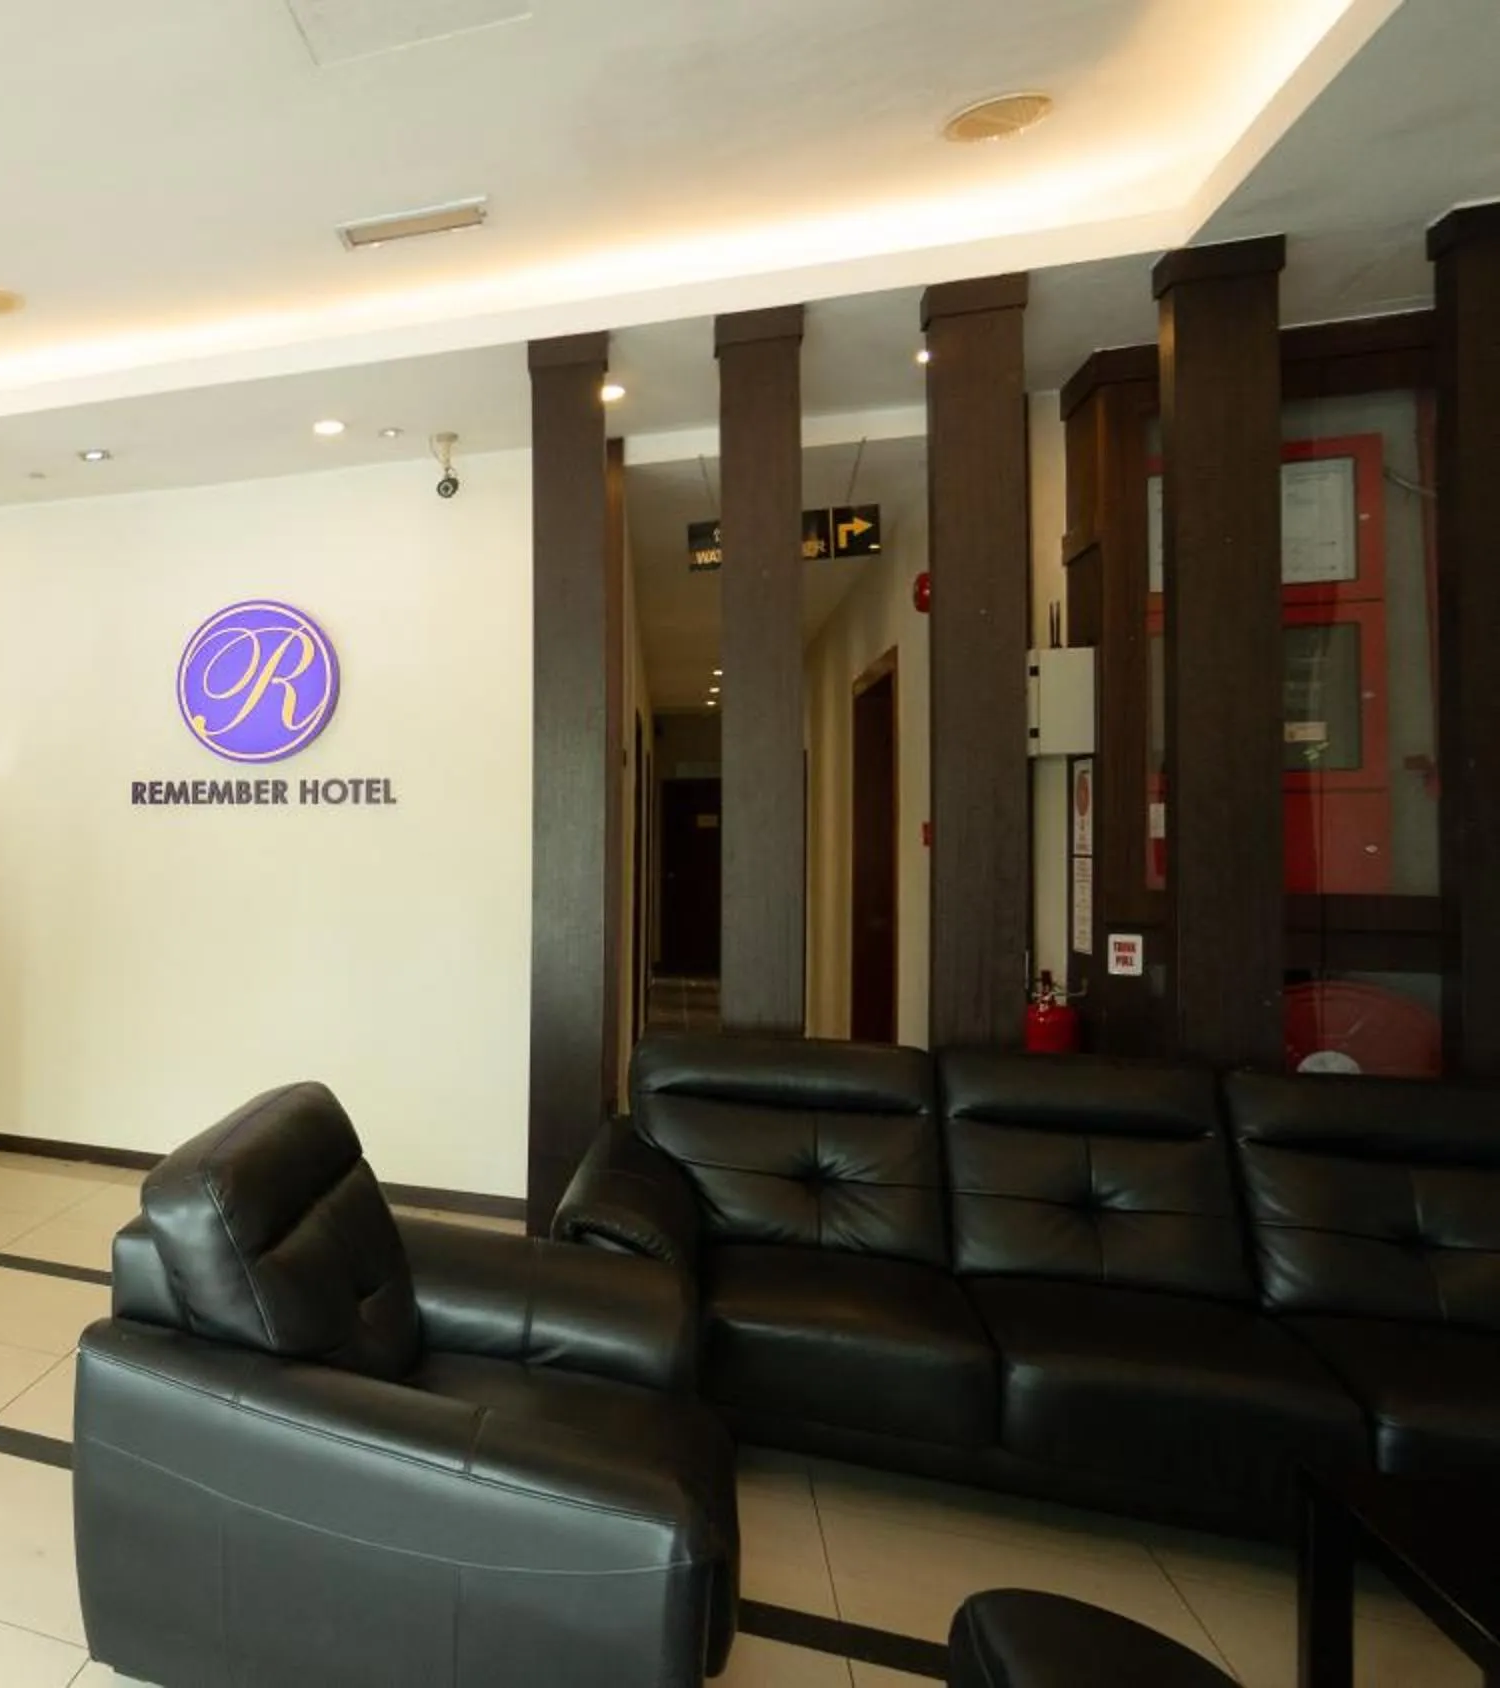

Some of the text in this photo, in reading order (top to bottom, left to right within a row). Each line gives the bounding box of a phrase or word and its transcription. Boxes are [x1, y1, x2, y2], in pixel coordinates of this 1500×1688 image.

[187, 626, 327, 737] R
[131, 778, 397, 805] REMEMBER HOTEL
